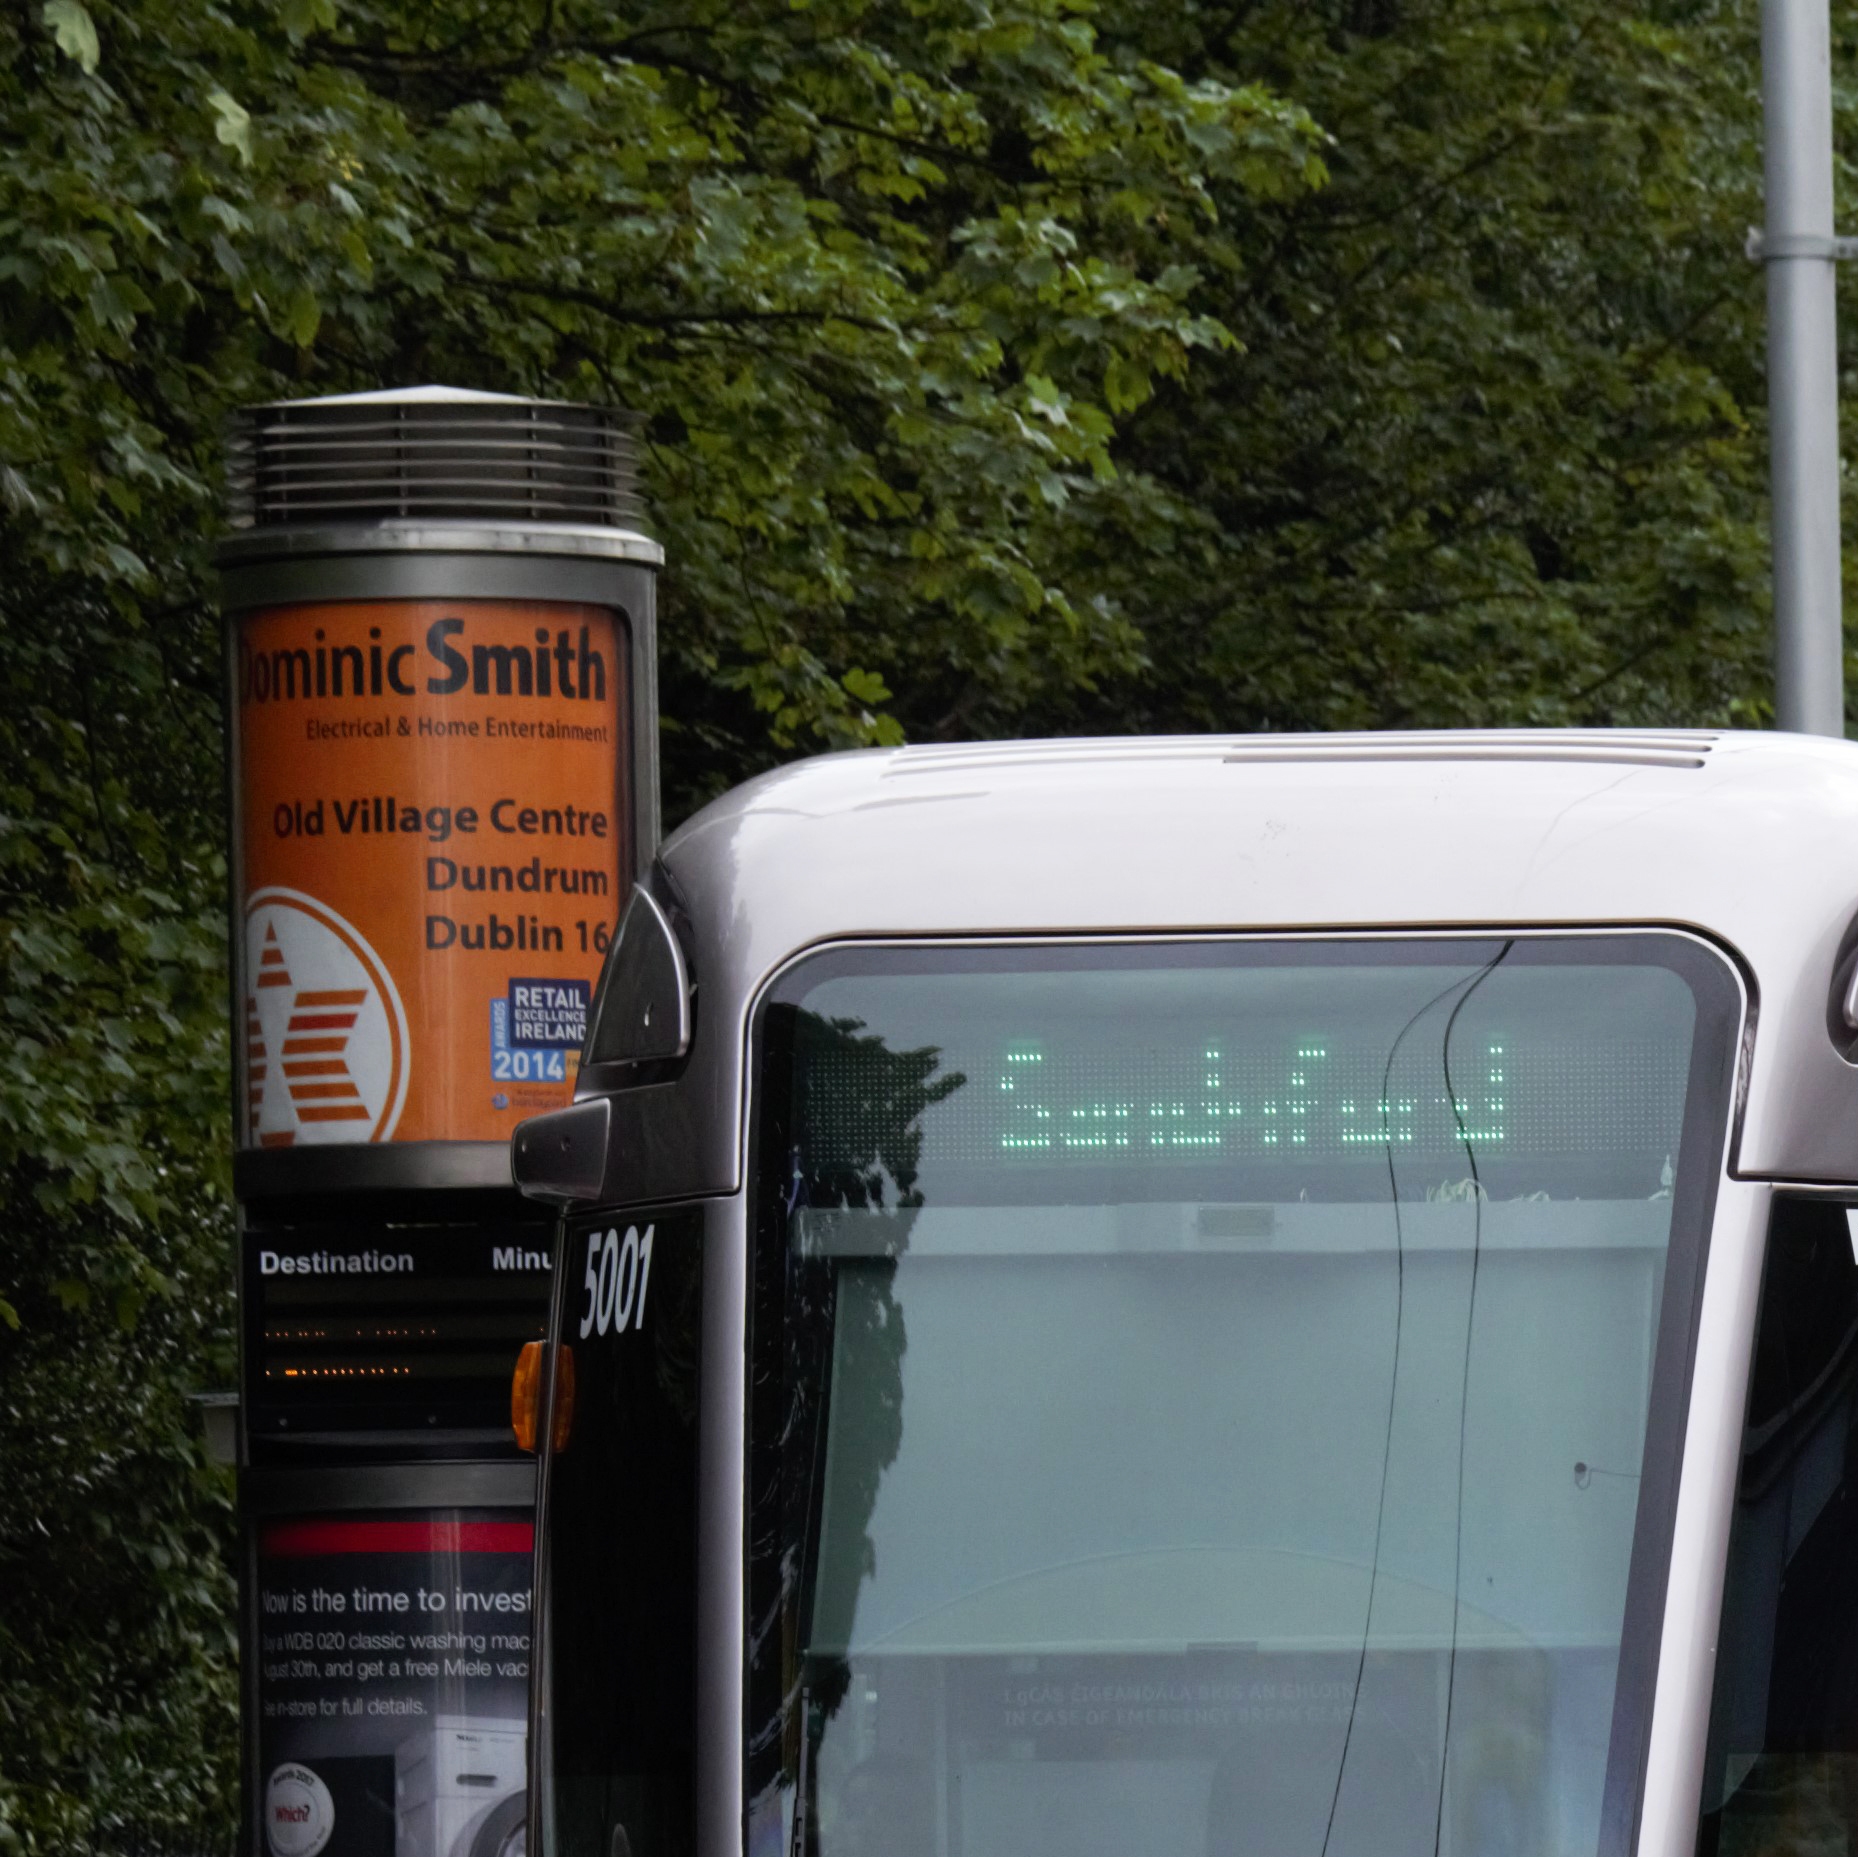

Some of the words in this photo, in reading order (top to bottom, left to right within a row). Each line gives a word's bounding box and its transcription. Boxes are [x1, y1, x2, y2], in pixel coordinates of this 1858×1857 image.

[426, 617, 606, 701] Smith
[307, 717, 390, 740] Electrical
[397, 717, 411, 736] &
[418, 716, 478, 737] Home
[487, 716, 608, 744] Entertainment
[274, 800, 324, 838] Old
[333, 797, 479, 842] Village
[490, 799, 608, 838] Centre
[427, 857, 608, 896] Dundrum
[425, 914, 563, 952] Dublin
[576, 921, 611, 955] 16
[515, 987, 586, 1008] RETAIL
[494, 1002, 506, 1048] AWARDS
[515, 1009, 586, 1023] EXCELLENCE
[515, 1022, 586, 1041] IRELAND
[494, 1051, 563, 1080] 2014
[260, 1249, 414, 1274] Destination
[580, 1224, 655, 1339] 5001
[292, 1588, 307, 1613] is
[311, 1587, 346, 1613] the
[352, 1586, 410, 1612] time
[418, 1587, 447, 1612] to
[455, 1587, 532, 1612] invest
[316, 1631, 345, 1650] 020
[348, 1631, 405, 1650] classic
[411, 1631, 487, 1653] washing
[325, 1659, 353, 1678] and
[357, 1659, 384, 1682] get
[388, 1663, 400, 1677] a
[405, 1658, 439, 1677] free
[444, 1658, 492, 1677] Miele
[319, 1697, 338, 1716] for
[342, 1697, 363, 1716] full
[367, 1697, 428, 1716] details.
[1004, 1710, 1025, 1726] IN
[1032, 1710, 1080, 1726] CASE
[1086, 1710, 1110, 1725] OF
[274, 1803, 311, 1823] Which?
